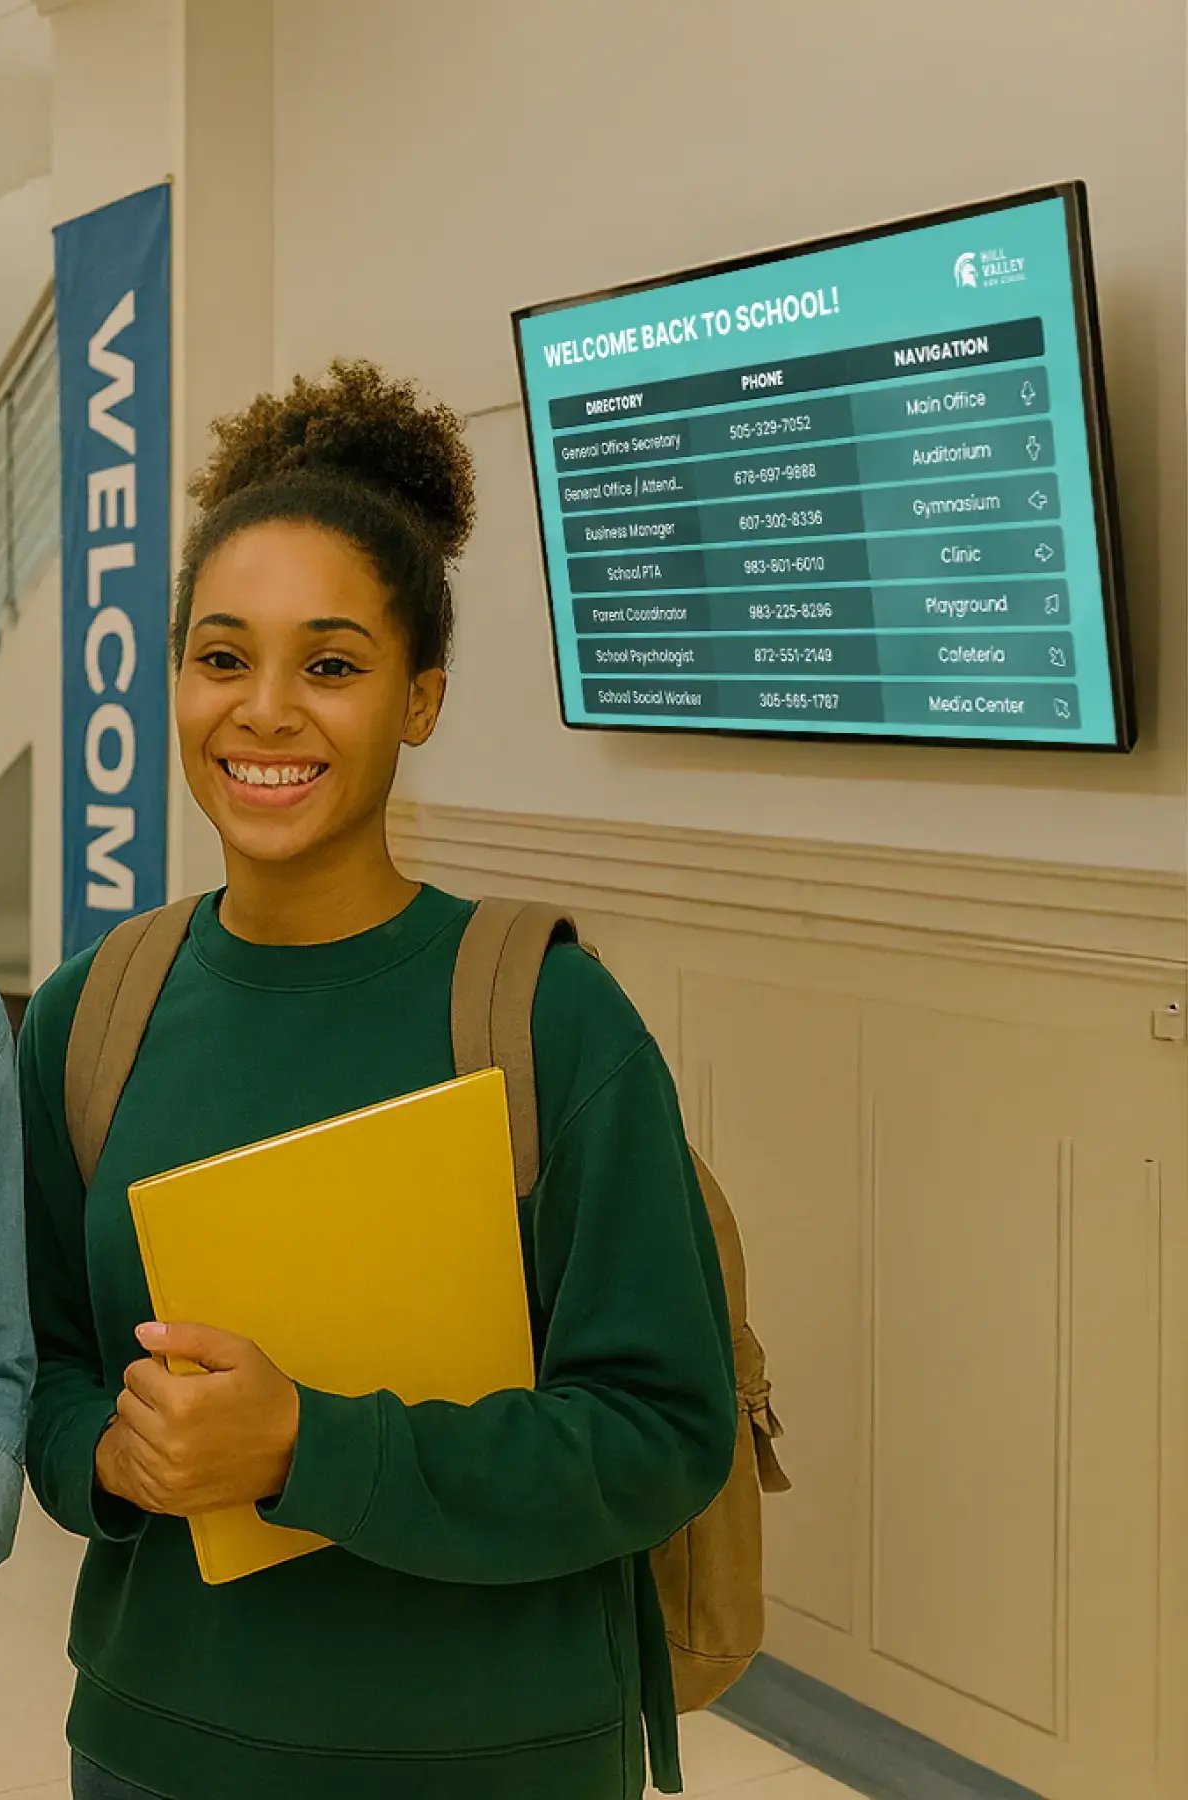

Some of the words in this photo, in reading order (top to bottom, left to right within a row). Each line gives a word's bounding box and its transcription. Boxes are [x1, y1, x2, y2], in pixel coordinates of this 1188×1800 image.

[981, 257, 1025, 277] VALLEY
[544, 328, 639, 368] WELCOME
[641, 315, 698, 349] BACK
[702, 309, 731, 336] TO
[735, 286, 840, 332] SCHOOL!
[894, 336, 989, 367] NAVIGATION
[741, 370, 784, 390] PHONE
[585, 393, 644, 416] DIRECTORY
[906, 396, 941, 416] Main
[943, 391, 987, 410] Office
[729, 415, 811, 440] 505-329-7052
[562, 437, 599, 460] General
[601, 437, 630, 455] Office
[632, 432, 681, 452] Secretary
[912, 442, 992, 466] Auditorium
[564, 484, 602, 501] General
[603, 482, 632, 497] Office
[912, 494, 1000, 519] Gymnasium
[739, 510, 822, 531] 607-302-8336
[585, 525, 628, 541] Business
[630, 522, 675, 538] Manager
[940, 546, 981, 563] Clinic
[607, 564, 641, 580] School
[642, 563, 662, 579] PTA
[593, 608, 624, 622] Parent
[626, 606, 687, 622] Coordinator
[925, 595, 1009, 618] Playground
[596, 649, 629, 663] School
[630, 649, 694, 667] Psychologist
[938, 645, 1005, 663] Cafeteria
[598, 690, 631, 704] School
[633, 690, 664, 705] Social
[665, 692, 702, 706] Worker
[928, 695, 972, 713] Media
[974, 697, 1024, 714] Center
